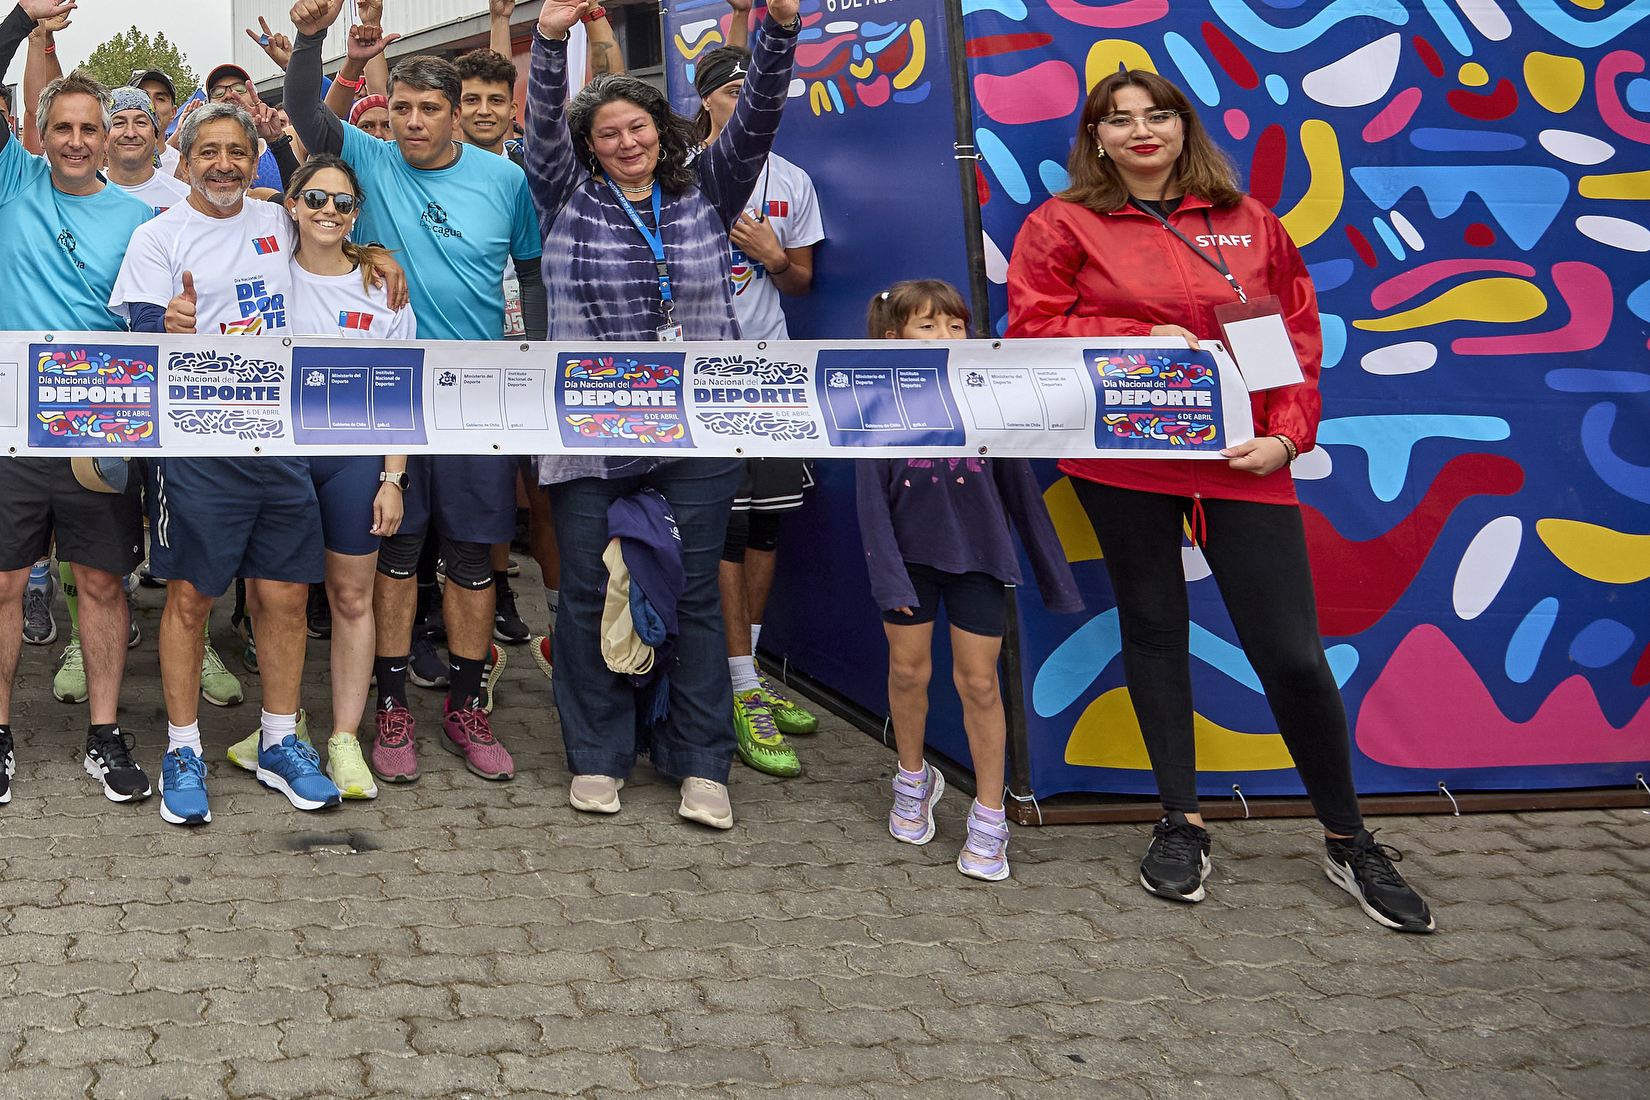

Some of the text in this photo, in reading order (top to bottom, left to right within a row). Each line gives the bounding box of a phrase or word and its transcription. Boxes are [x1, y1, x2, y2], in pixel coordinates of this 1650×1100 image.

[1195, 234, 1252, 248] STAFF
[236, 280, 268, 300] DE
[239, 294, 285, 318] POR
[263, 310, 286, 330] TE
[39, 376, 104, 384] Día Nacional del
[1103, 380, 1116, 388] Día
[1119, 380, 1153, 388] Nacional
[39, 386, 150, 403] DEPORTE
[169, 385, 280, 400] DEPORTE
[564, 390, 676, 406] DEPORTE
[694, 388, 807, 403] DEPORTE
[1104, 390, 1212, 406] DEPORTE
